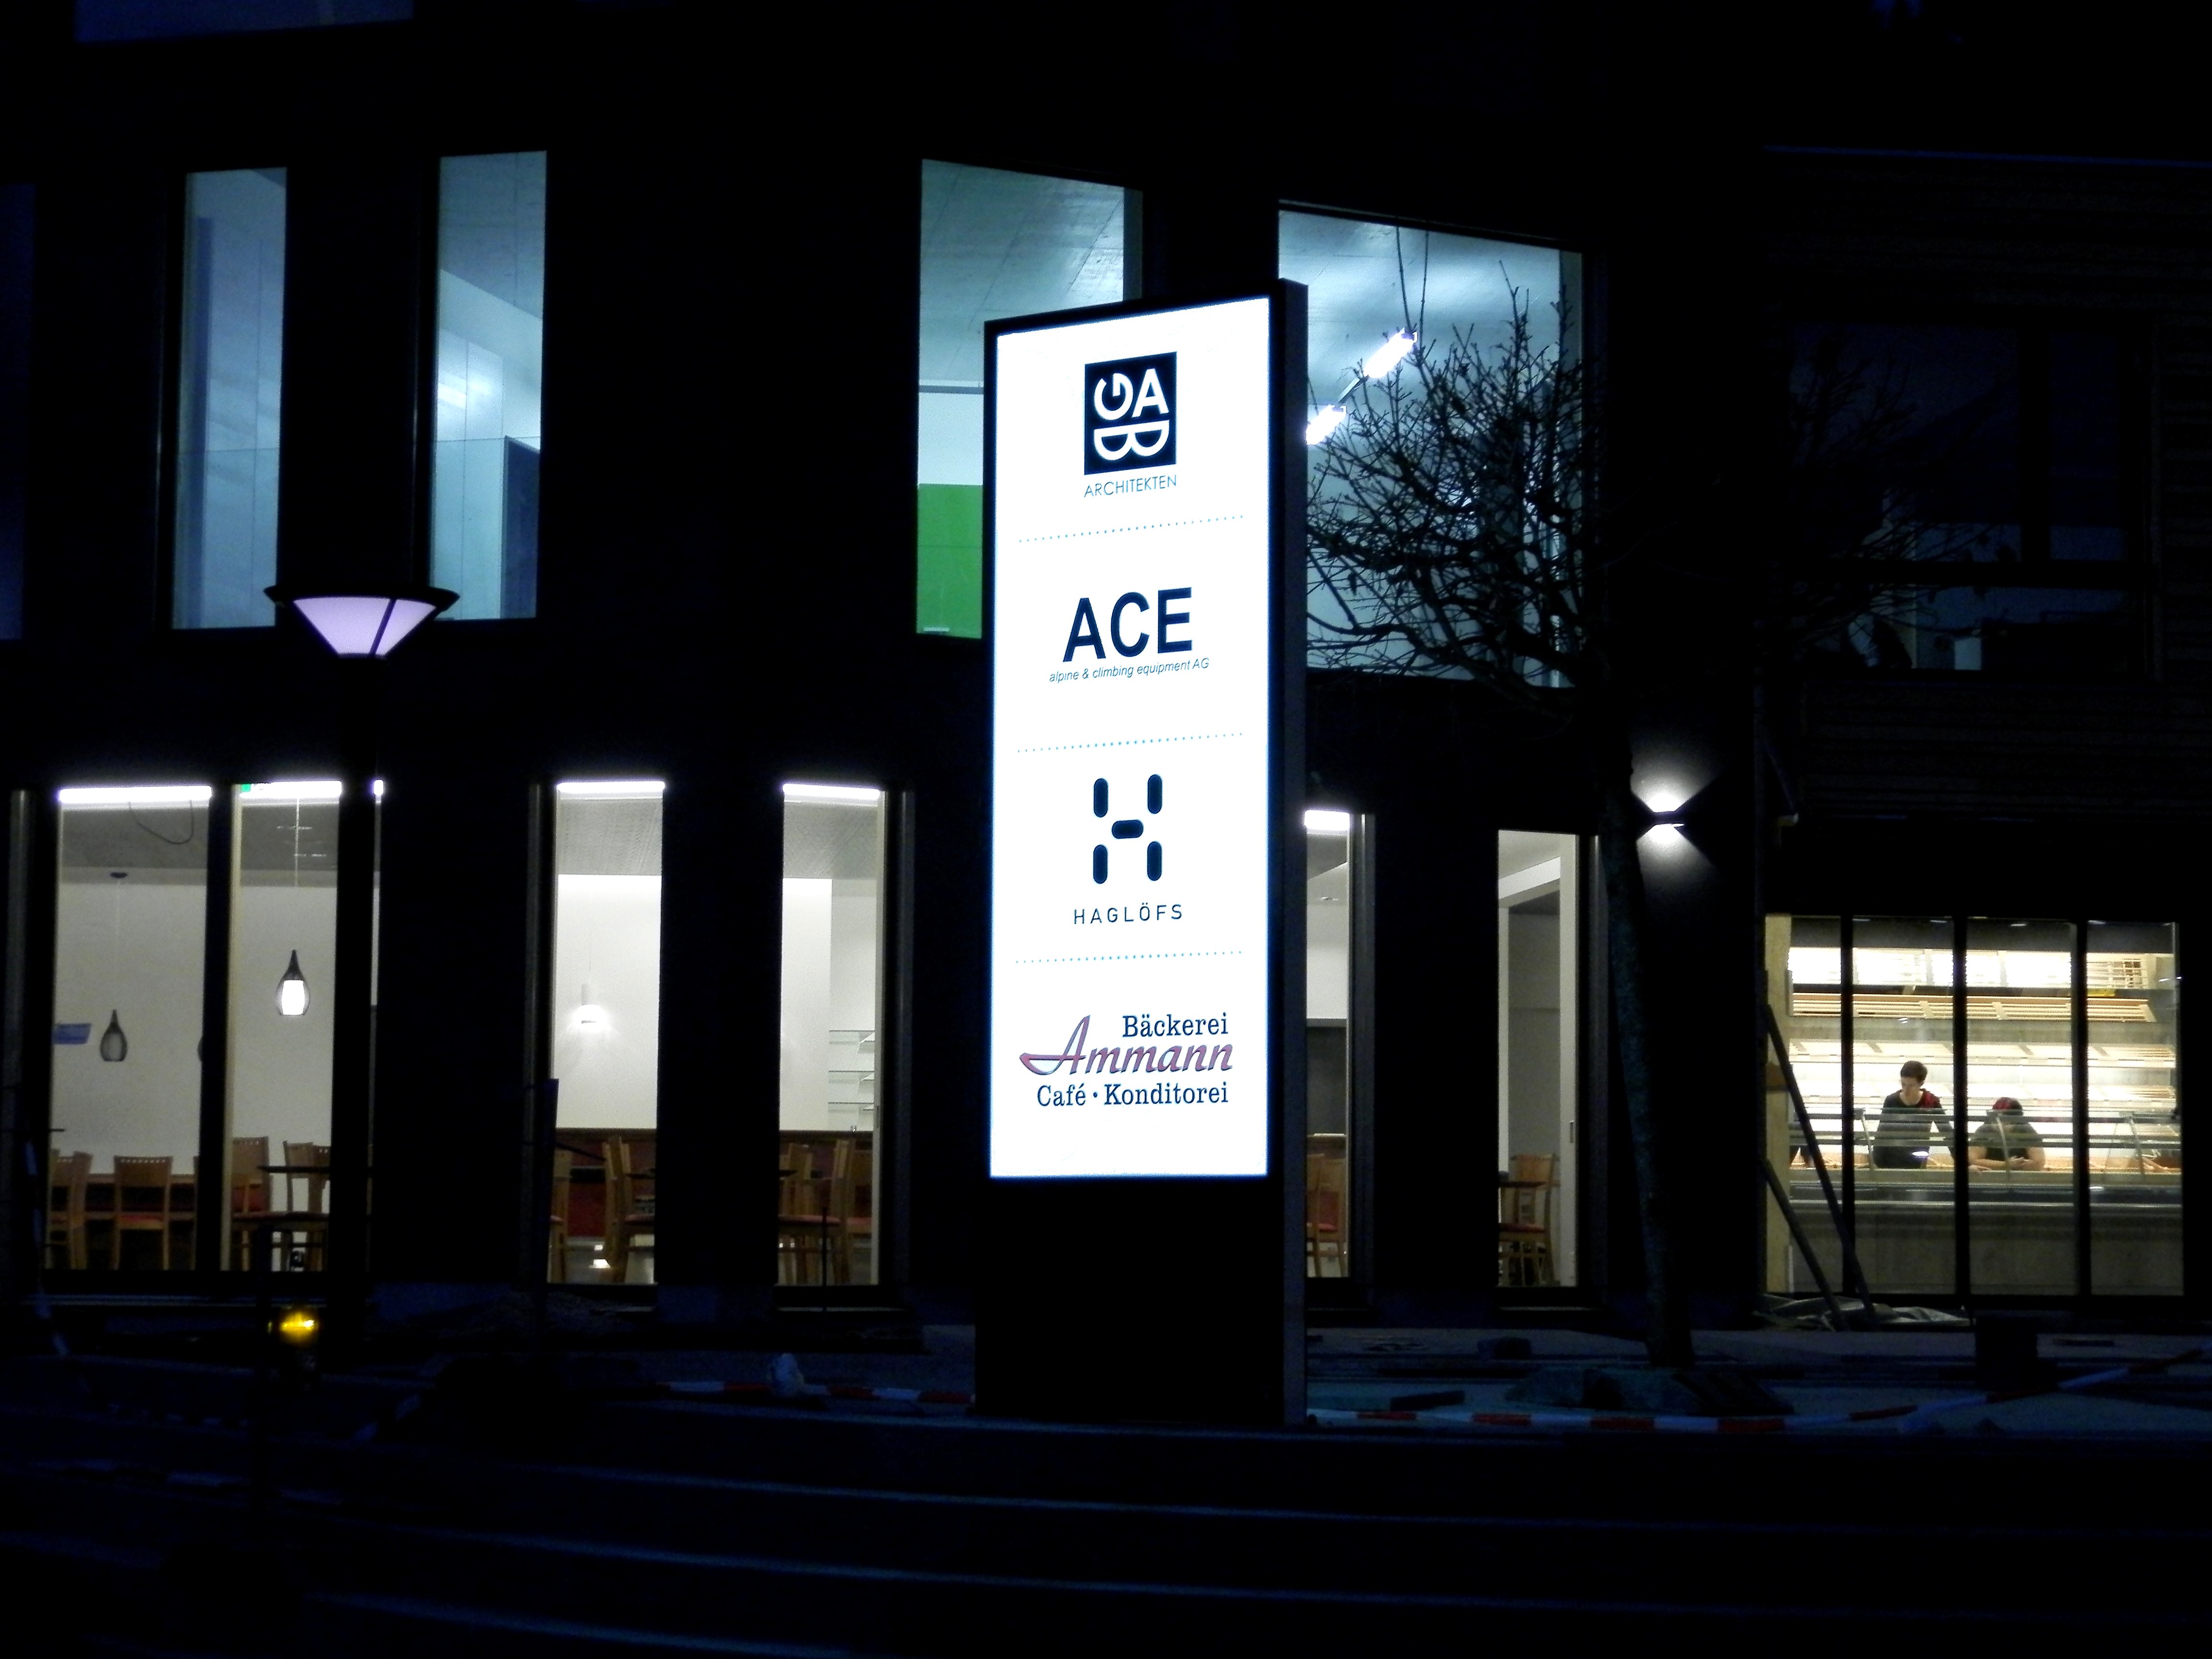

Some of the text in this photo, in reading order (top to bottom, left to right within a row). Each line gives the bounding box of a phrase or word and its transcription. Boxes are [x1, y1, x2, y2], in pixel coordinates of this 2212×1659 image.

[1084, 475, 1177, 497] ARCHITEKTEN
[1063, 587, 1193, 662] ACE
[1049, 658, 1209, 684] alpine & climbing equipment AG
[1074, 902, 1182, 924] HAGLÖFS
[1122, 1012, 1229, 1038] Bäckerei
[1019, 1015, 1233, 1076] Ammann
[1037, 1082, 1229, 1106] Café Konditorei
